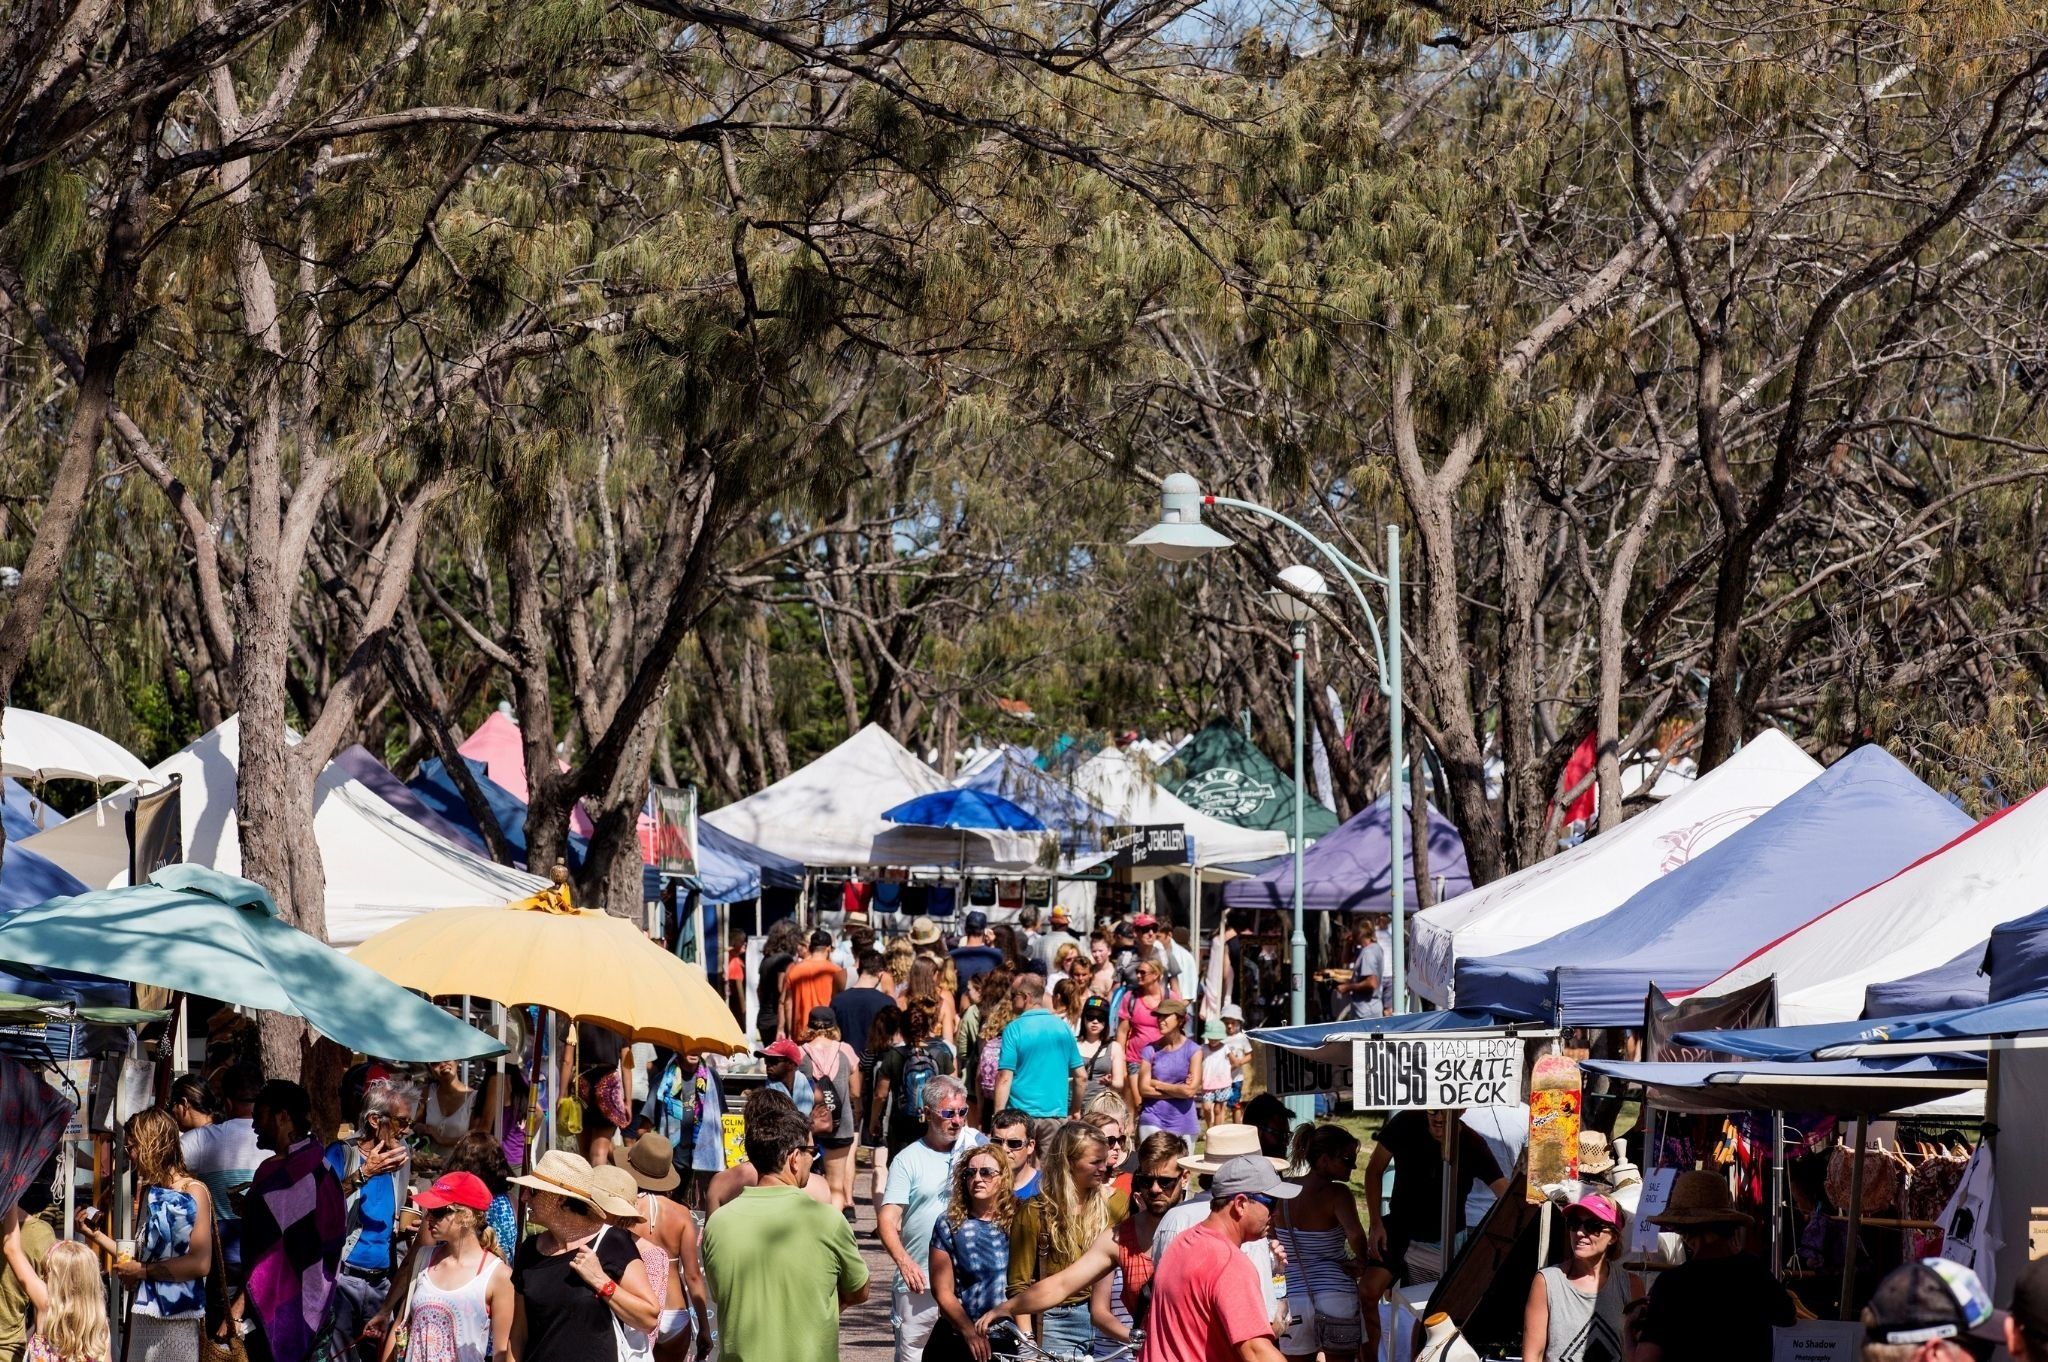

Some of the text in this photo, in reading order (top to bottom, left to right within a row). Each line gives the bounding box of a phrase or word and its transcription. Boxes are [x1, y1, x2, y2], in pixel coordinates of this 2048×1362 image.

[1147, 829, 1185, 852] JEWELLERY
[1433, 1040, 1517, 1058] MADE FROM
[1434, 1058, 1515, 1082] SKATE
[1440, 1081, 1507, 1105] DECK
[1865, 1141, 1878, 1150] ALE
[1648, 1182, 1660, 1191] SALE
[1645, 1194, 1657, 1203] RACK
[1792, 1340, 1837, 1349] No Shadow
